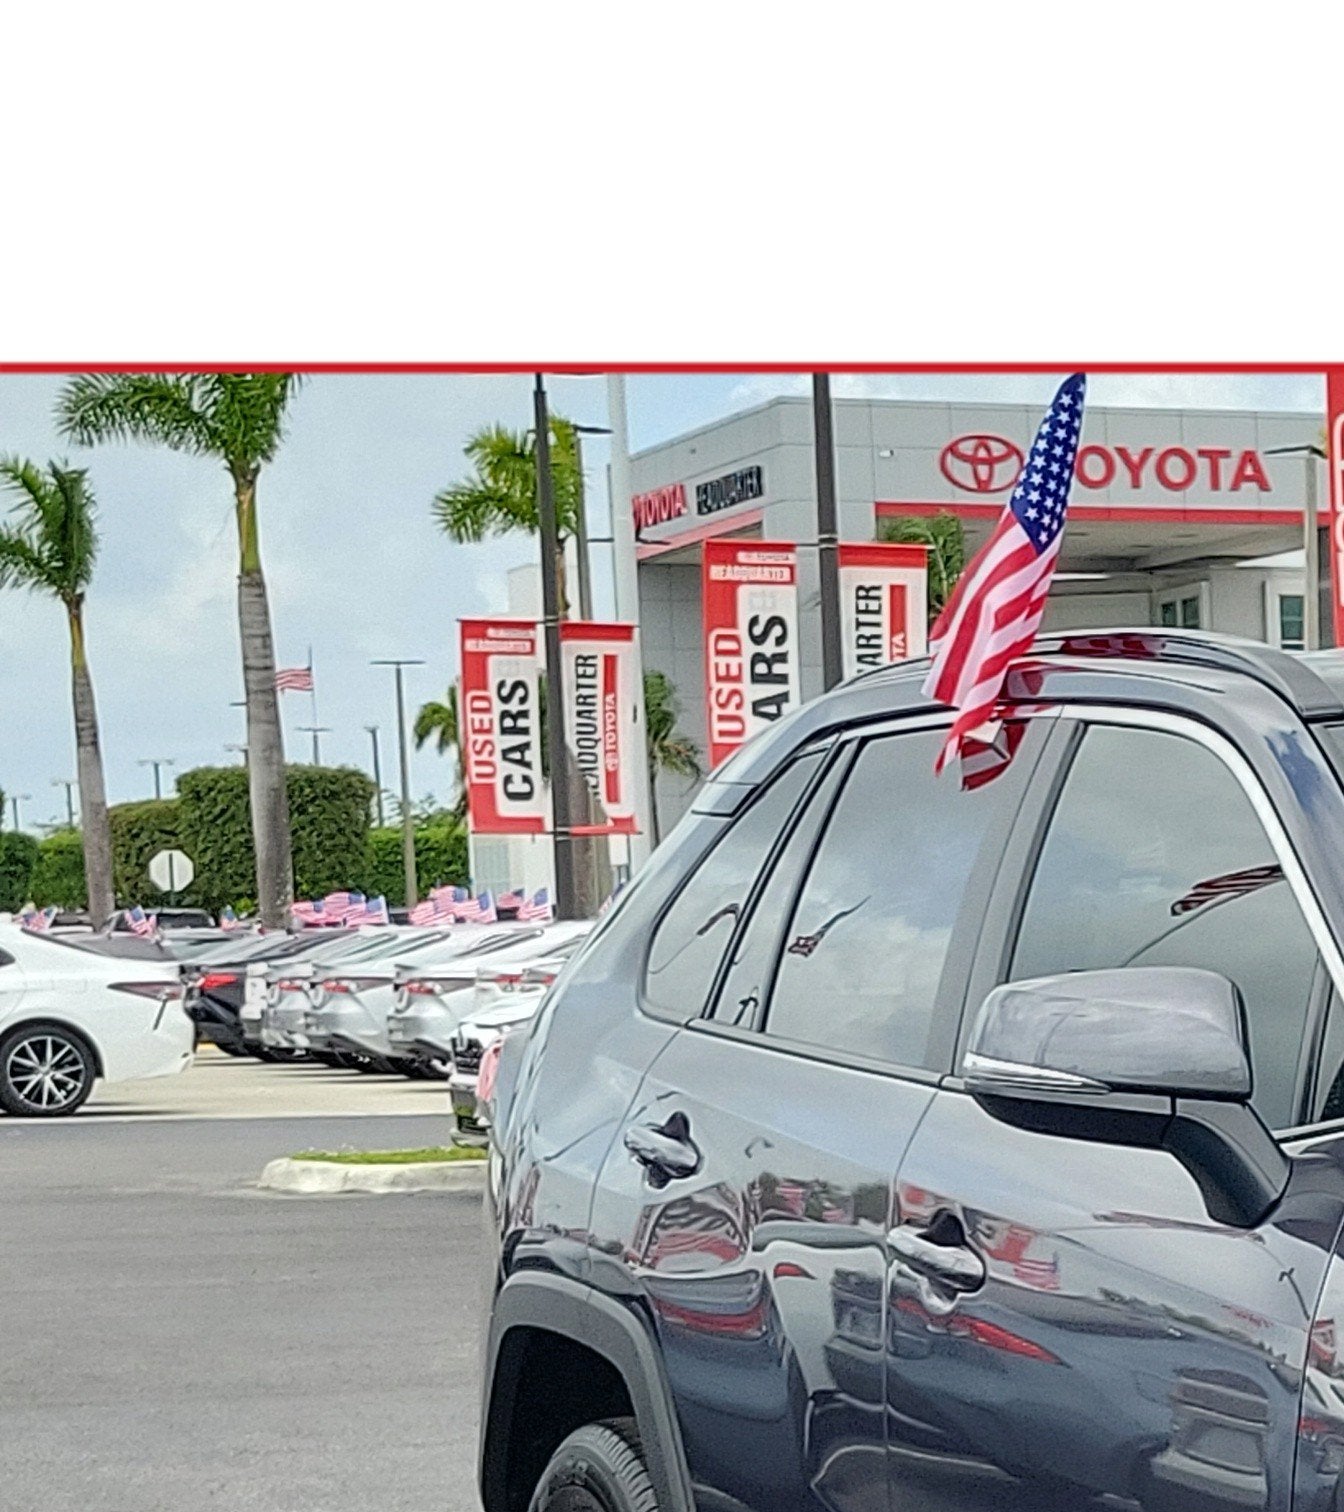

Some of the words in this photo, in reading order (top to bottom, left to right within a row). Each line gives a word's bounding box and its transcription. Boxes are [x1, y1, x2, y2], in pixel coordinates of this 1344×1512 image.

[1075, 444, 1273, 491] OYOTA
[713, 633, 746, 739] USED
[748, 614, 791, 722] ARS
[470, 694, 497, 779] USED
[497, 678, 535, 803] CARS
[574, 653, 601, 797] ADQUARTER
